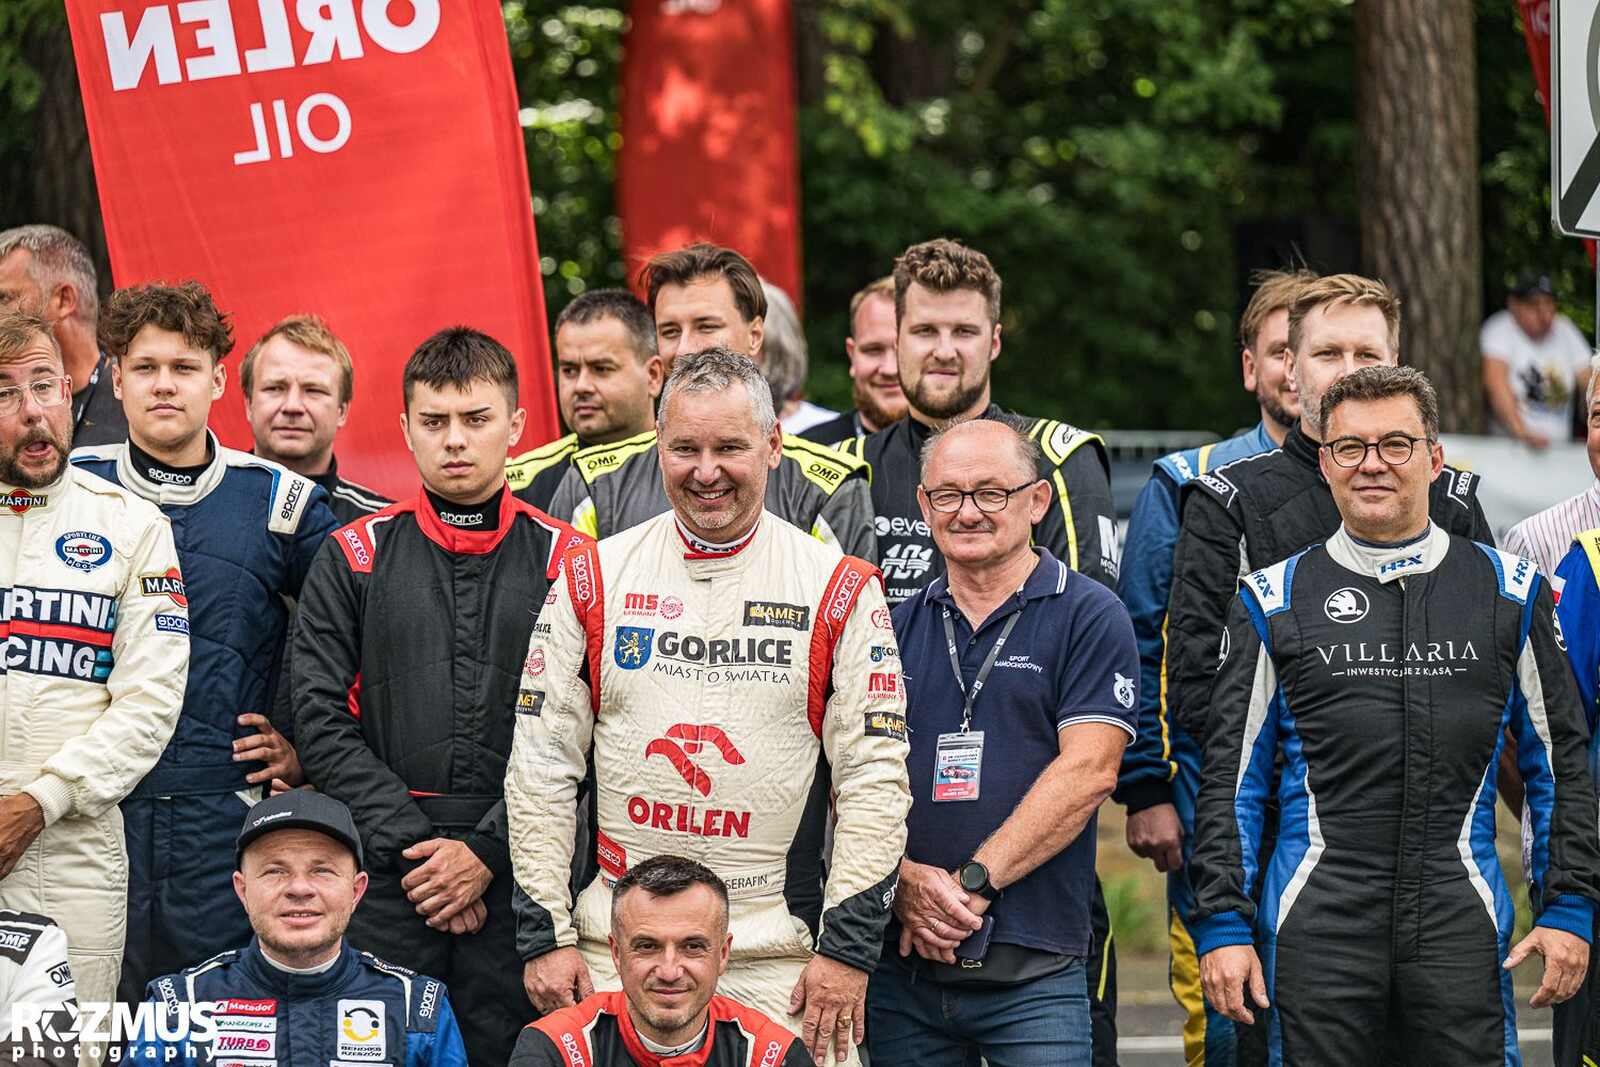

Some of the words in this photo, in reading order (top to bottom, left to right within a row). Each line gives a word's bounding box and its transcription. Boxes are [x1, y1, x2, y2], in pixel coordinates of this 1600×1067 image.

[587, 455, 617, 472] OMP
[809, 463, 840, 481] OMP
[148, 467, 192, 484] sparco
[506, 469, 525, 481] MP
[281, 479, 305, 521] sparco
[440, 511, 484, 526] sparco
[343, 529, 370, 566] sparco
[1380, 553, 1424, 575] HRX
[572, 554, 591, 601] sparco
[1252, 571, 1275, 598] HRX
[830, 570, 860, 621] sparco
[657, 631, 793, 665] GORLICE
[1009, 655, 1030, 663] SPORT
[1316, 640, 1480, 665] VILLARIA
[653, 662, 720, 683] MIASTO
[1415, 667, 1421, 676] Z
[628, 796, 752, 838] ORLEN
[726, 874, 768, 890] SERAFIN
[229, 1003, 273, 1012] Matador
[419, 980, 439, 1018] sparco
[560, 1032, 586, 1067] spar
